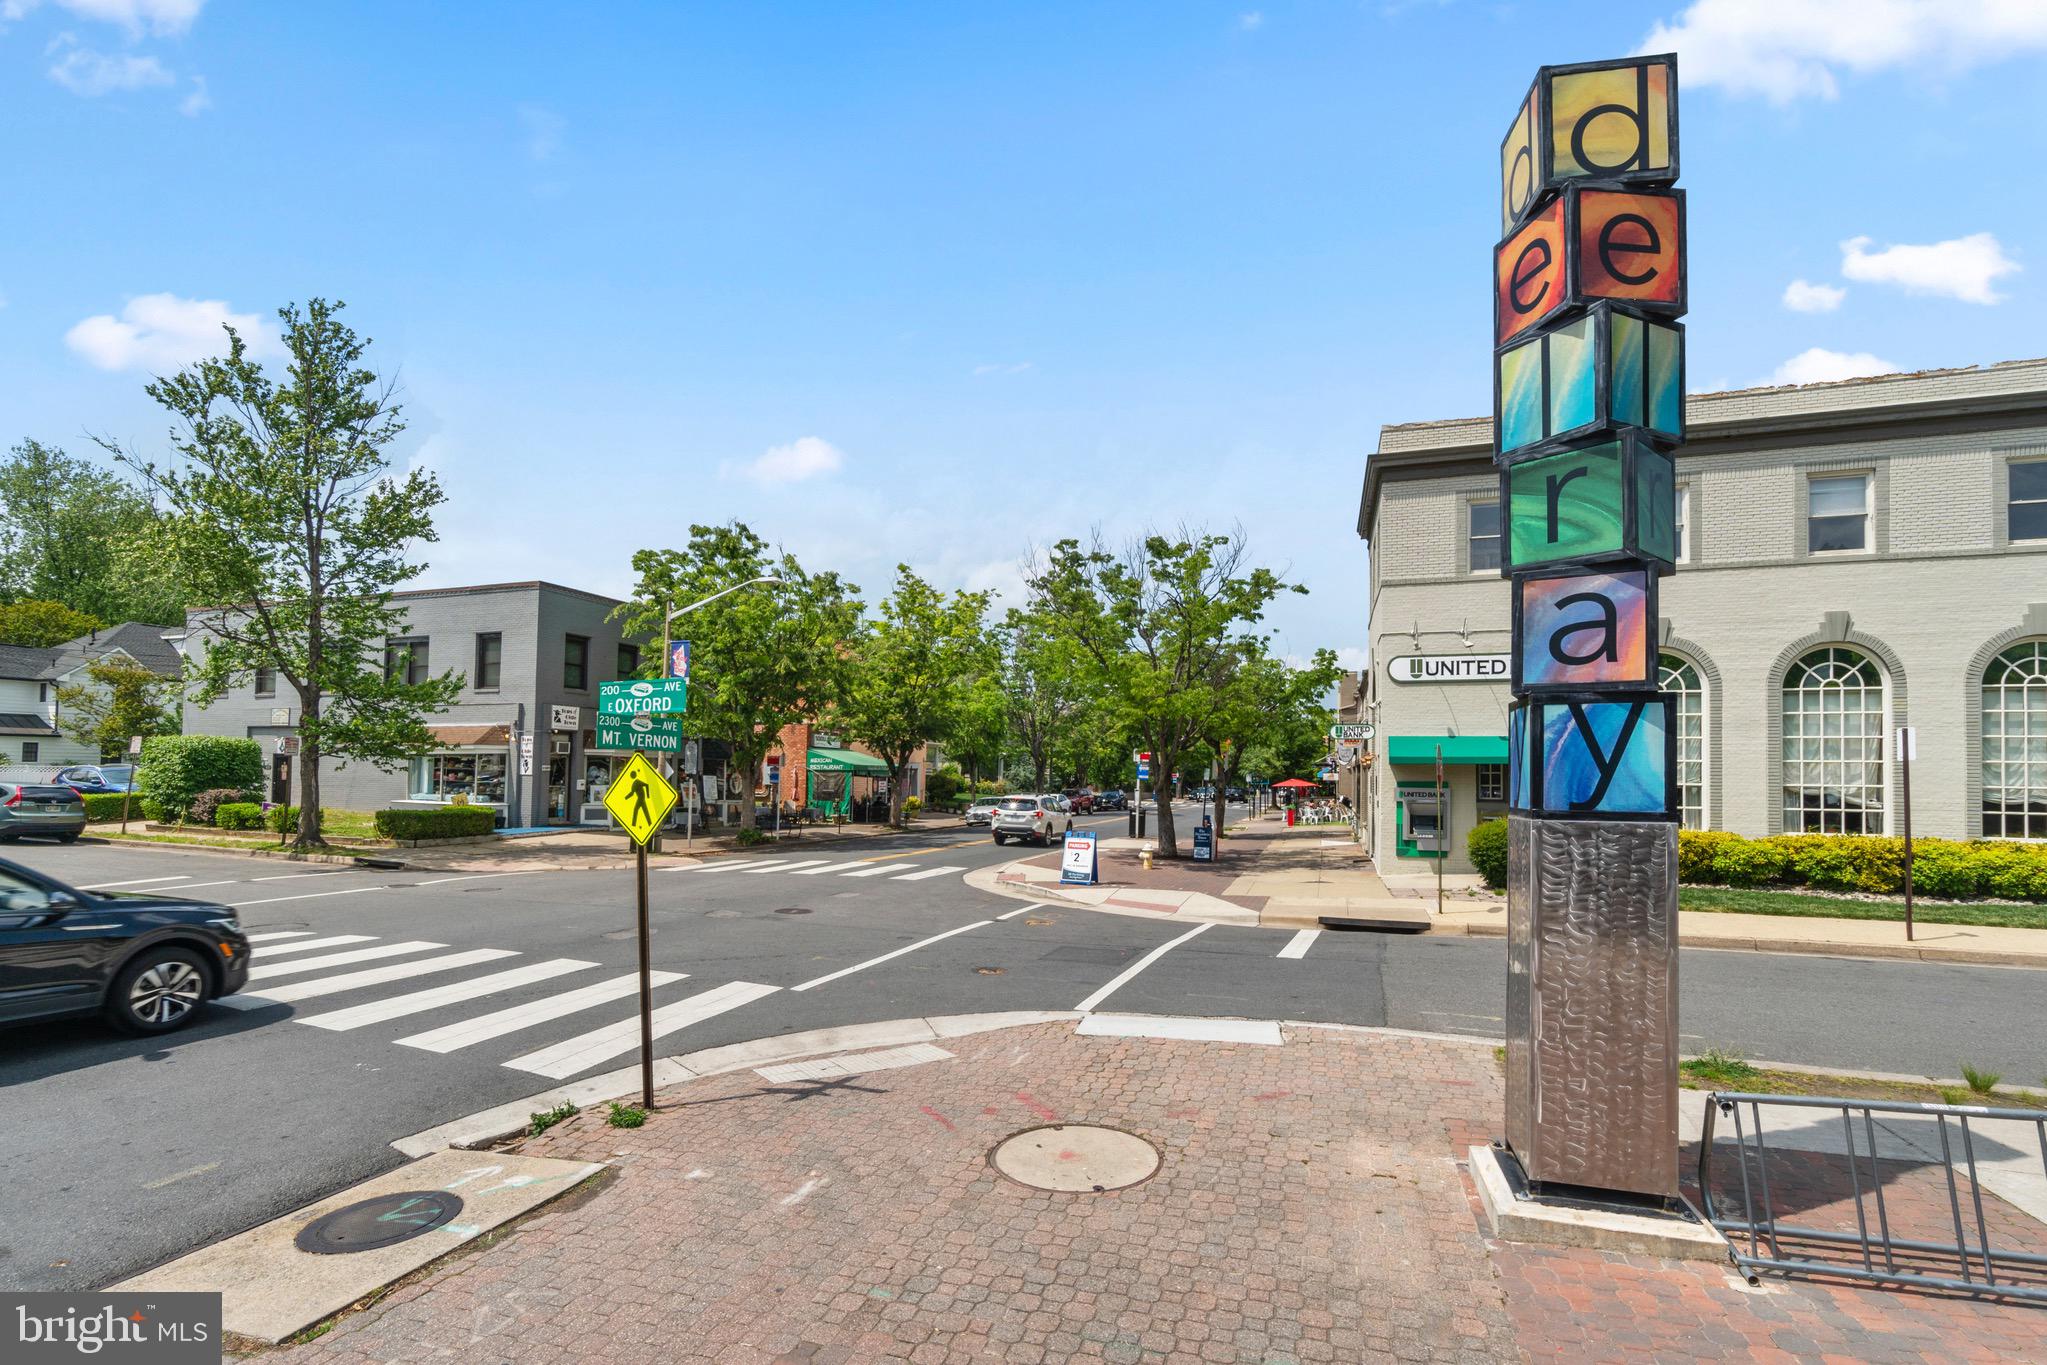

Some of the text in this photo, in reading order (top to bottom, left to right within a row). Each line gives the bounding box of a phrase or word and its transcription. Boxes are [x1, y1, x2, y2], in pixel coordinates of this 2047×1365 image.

[1425, 660, 1507, 676] UNITED
[601, 681, 682, 696] 200 AVE
[608, 697, 671, 713] E OXFORD
[600, 715, 678, 731] 2300 AVE
[602, 730, 677, 749] MT. VERNON
